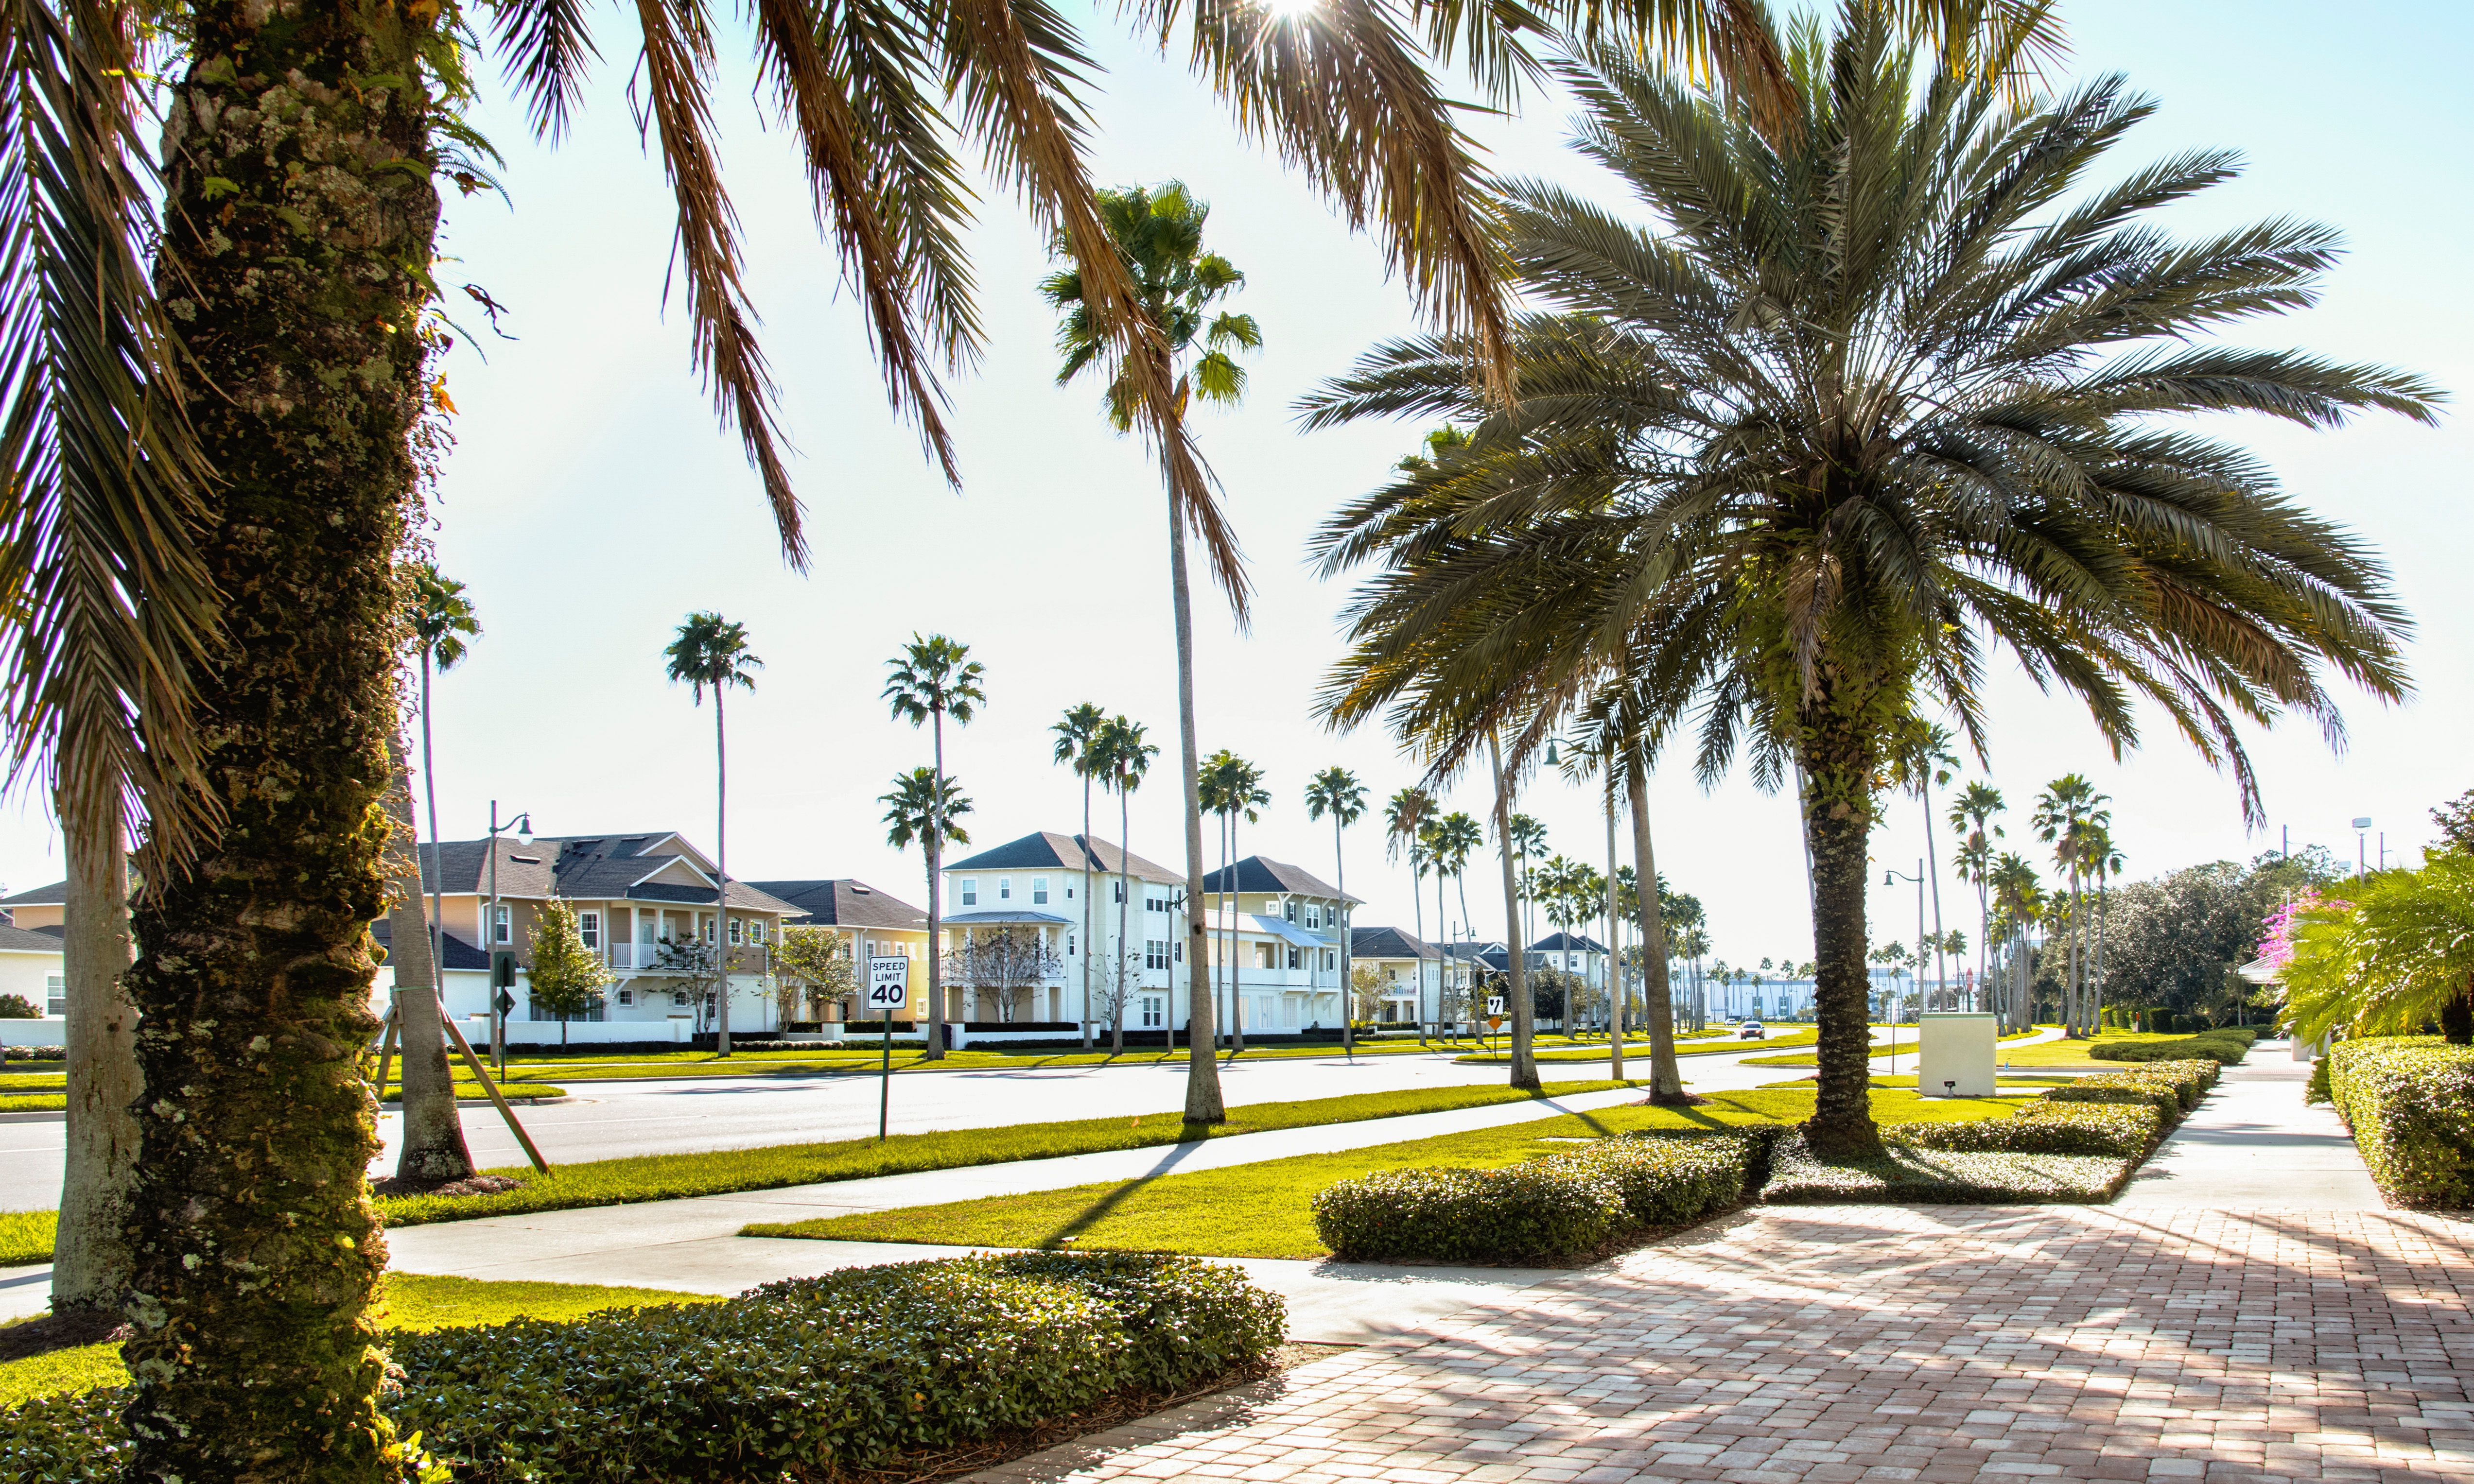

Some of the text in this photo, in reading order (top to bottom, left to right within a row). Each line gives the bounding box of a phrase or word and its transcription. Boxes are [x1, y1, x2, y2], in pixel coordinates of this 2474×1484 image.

[872, 962, 905, 970] SPEED
[876, 973, 901, 981] LIMIT
[871, 984, 903, 1003] 40
